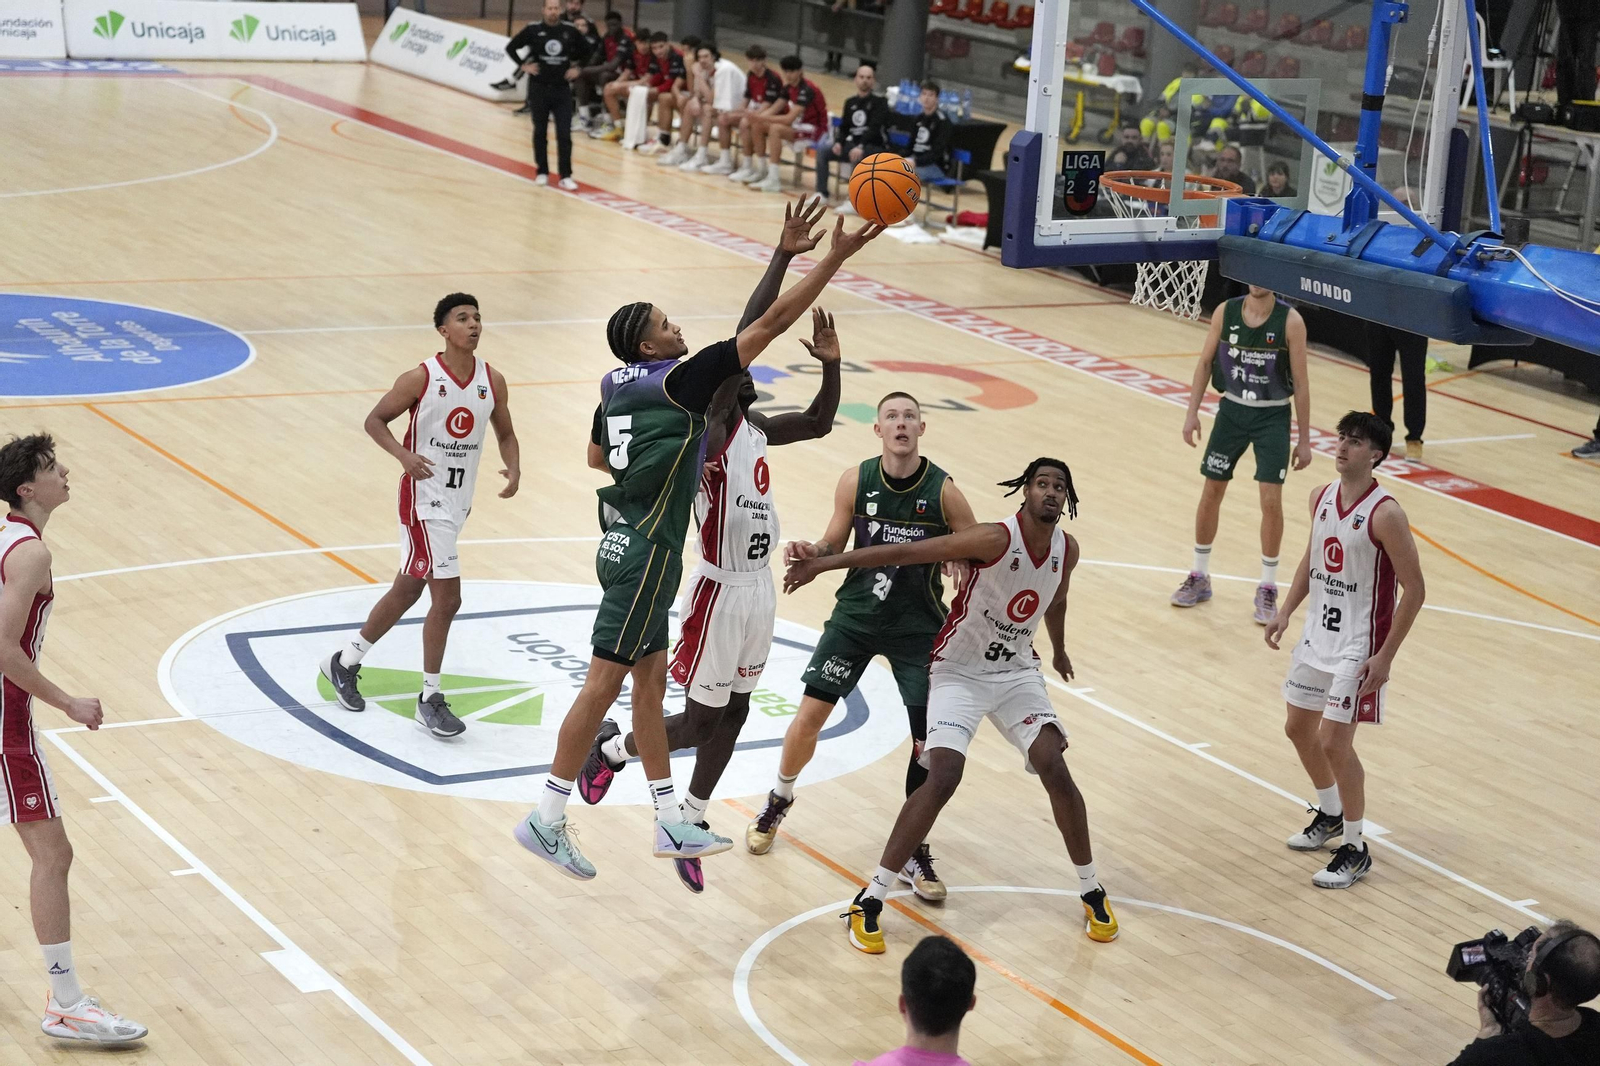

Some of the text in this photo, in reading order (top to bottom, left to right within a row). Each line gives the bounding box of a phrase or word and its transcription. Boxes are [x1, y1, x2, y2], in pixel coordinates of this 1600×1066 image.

[0, 18, 53, 29] undación
[131, 22, 205, 43] Unicaja
[409, 24, 445, 44] Fundación
[0, 29, 38, 40] nicaja
[266, 25, 336, 46] Unicaja
[468, 41, 505, 63] Fundación
[1065, 154, 1101, 169] LIGA
[1300, 276, 1352, 303] MONDO
[1241, 350, 1276, 360] Fundación
[606, 415, 633, 470] 5
[445, 467, 465, 489] 17
[747, 533, 771, 560] 23
[984, 641, 1017, 662] 34
